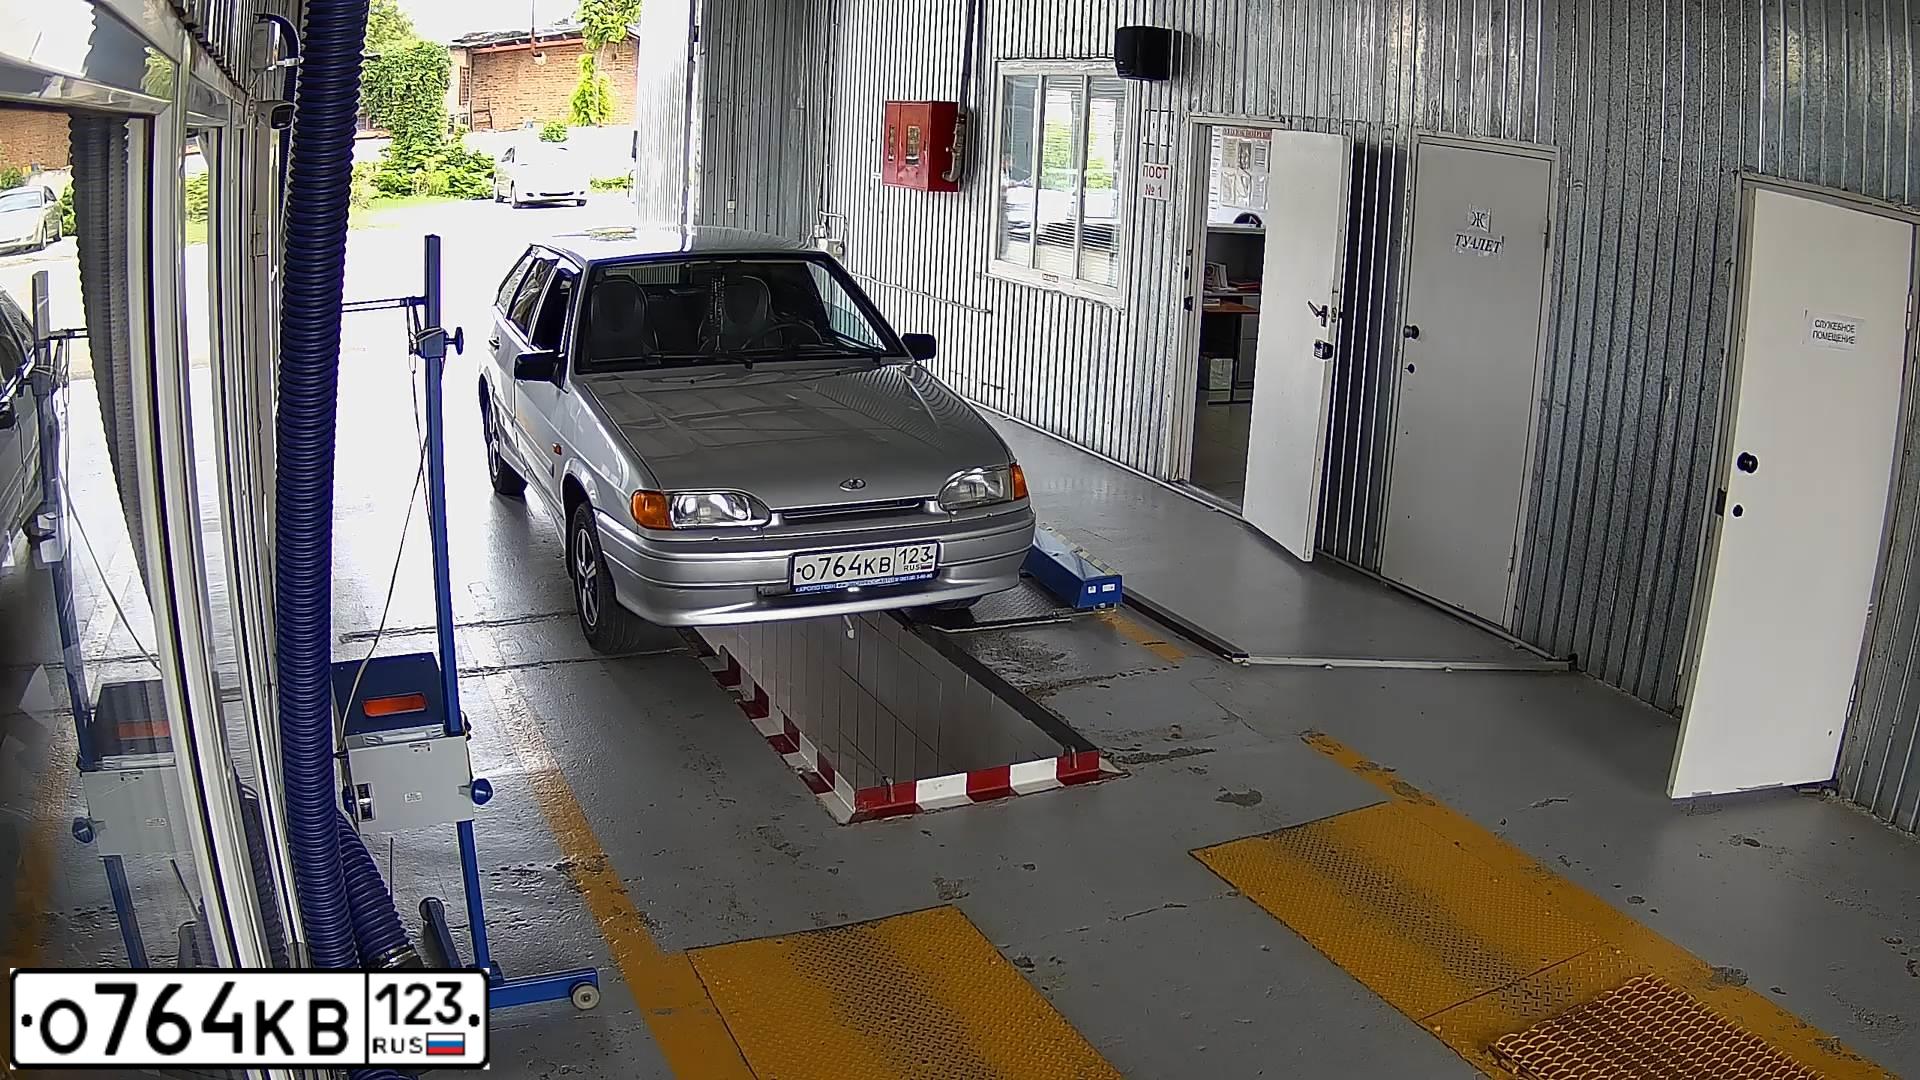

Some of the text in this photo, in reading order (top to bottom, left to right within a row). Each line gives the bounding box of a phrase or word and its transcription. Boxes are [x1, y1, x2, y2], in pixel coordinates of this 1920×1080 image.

[1143, 165, 1169, 179] ПОСТ
[1471, 211, 1487, 228] Ж
[1456, 233, 1502, 253] ТУАЛЕТ
[1814, 319, 1855, 333] СЛУЖЕБНОЕ
[1812, 330, 1856, 344] ПОМЕЩЕНИЕ
[801, 546, 930, 581] О764КВ 123
